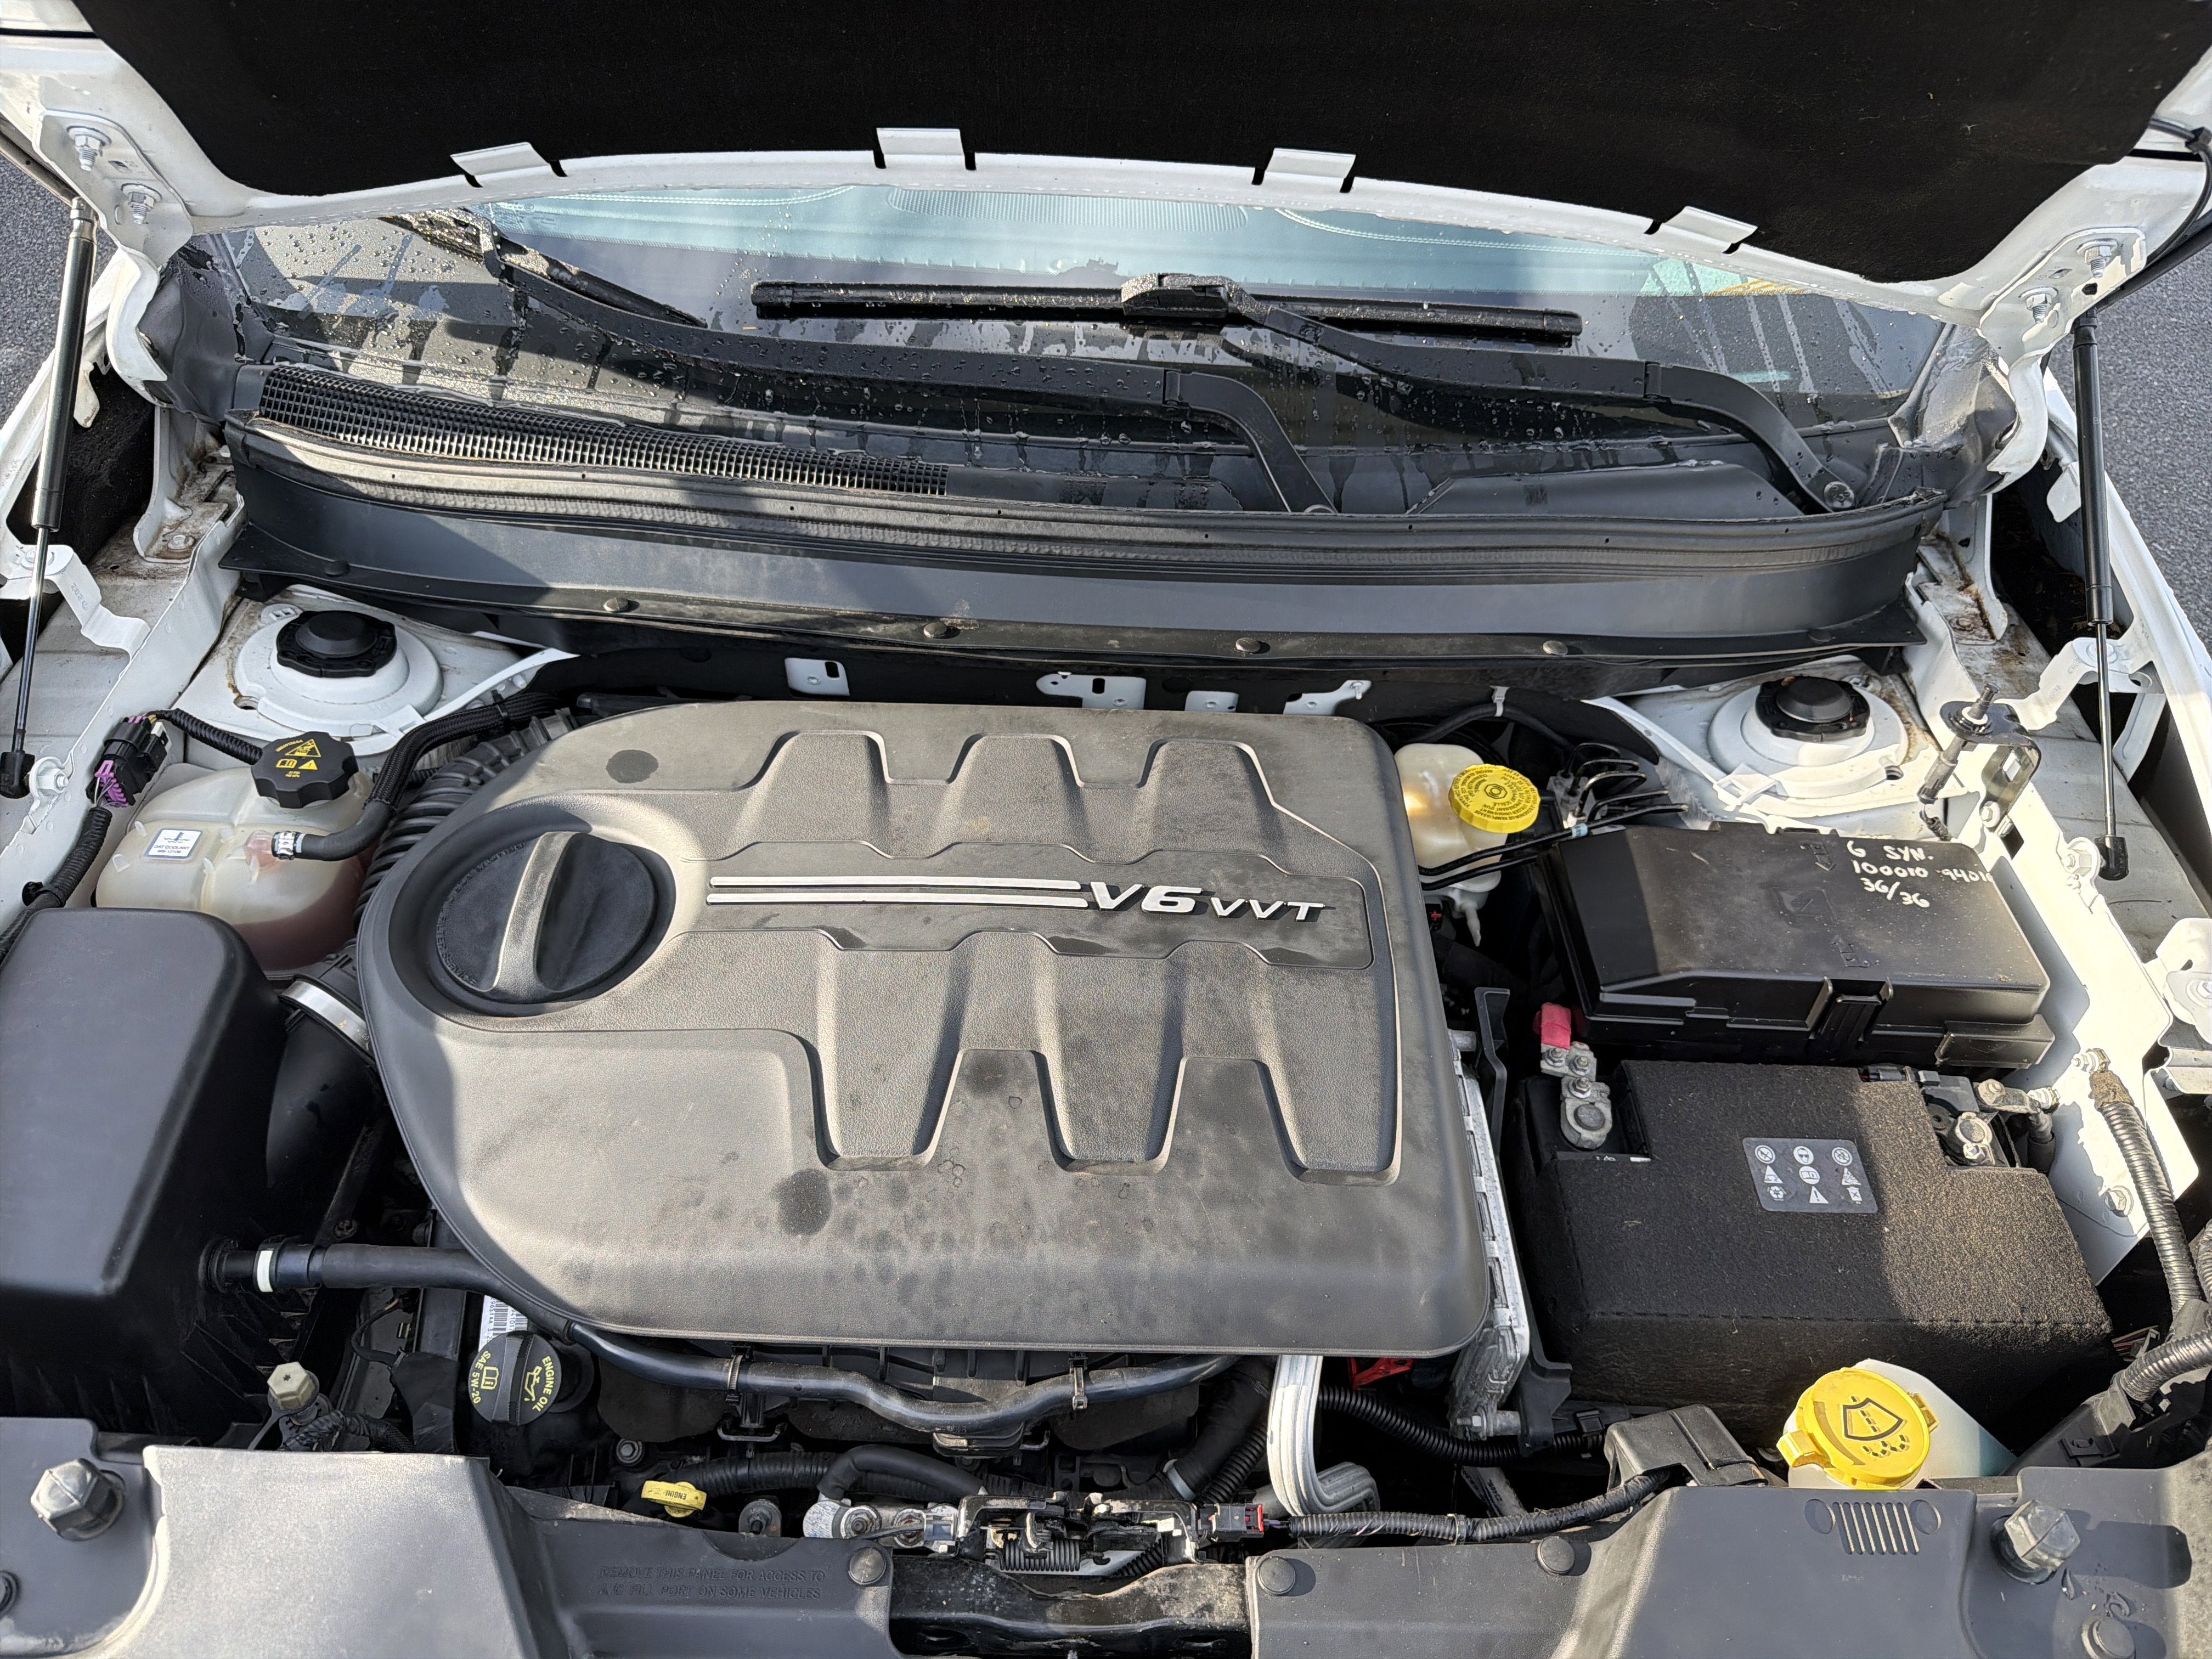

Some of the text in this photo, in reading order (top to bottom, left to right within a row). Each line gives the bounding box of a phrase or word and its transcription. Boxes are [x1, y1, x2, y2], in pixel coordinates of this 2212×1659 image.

[1090, 882, 1327, 923] V6 VVT
[437, 915, 447, 951] FILTER
[470, 1350, 491, 1404] SAE 5W-20
[532, 1356, 555, 1412] ENGINE OIL
[601, 1566, 826, 1582] REMOVE THIS PANEL FOR ACCESS TO
[631, 1583, 654, 1596] FILL
[661, 1585, 693, 1596] PORT
[697, 1585, 715, 1597] ON
[719, 1586, 756, 1598] SOME
[761, 1587, 821, 1599] VEHICLES
